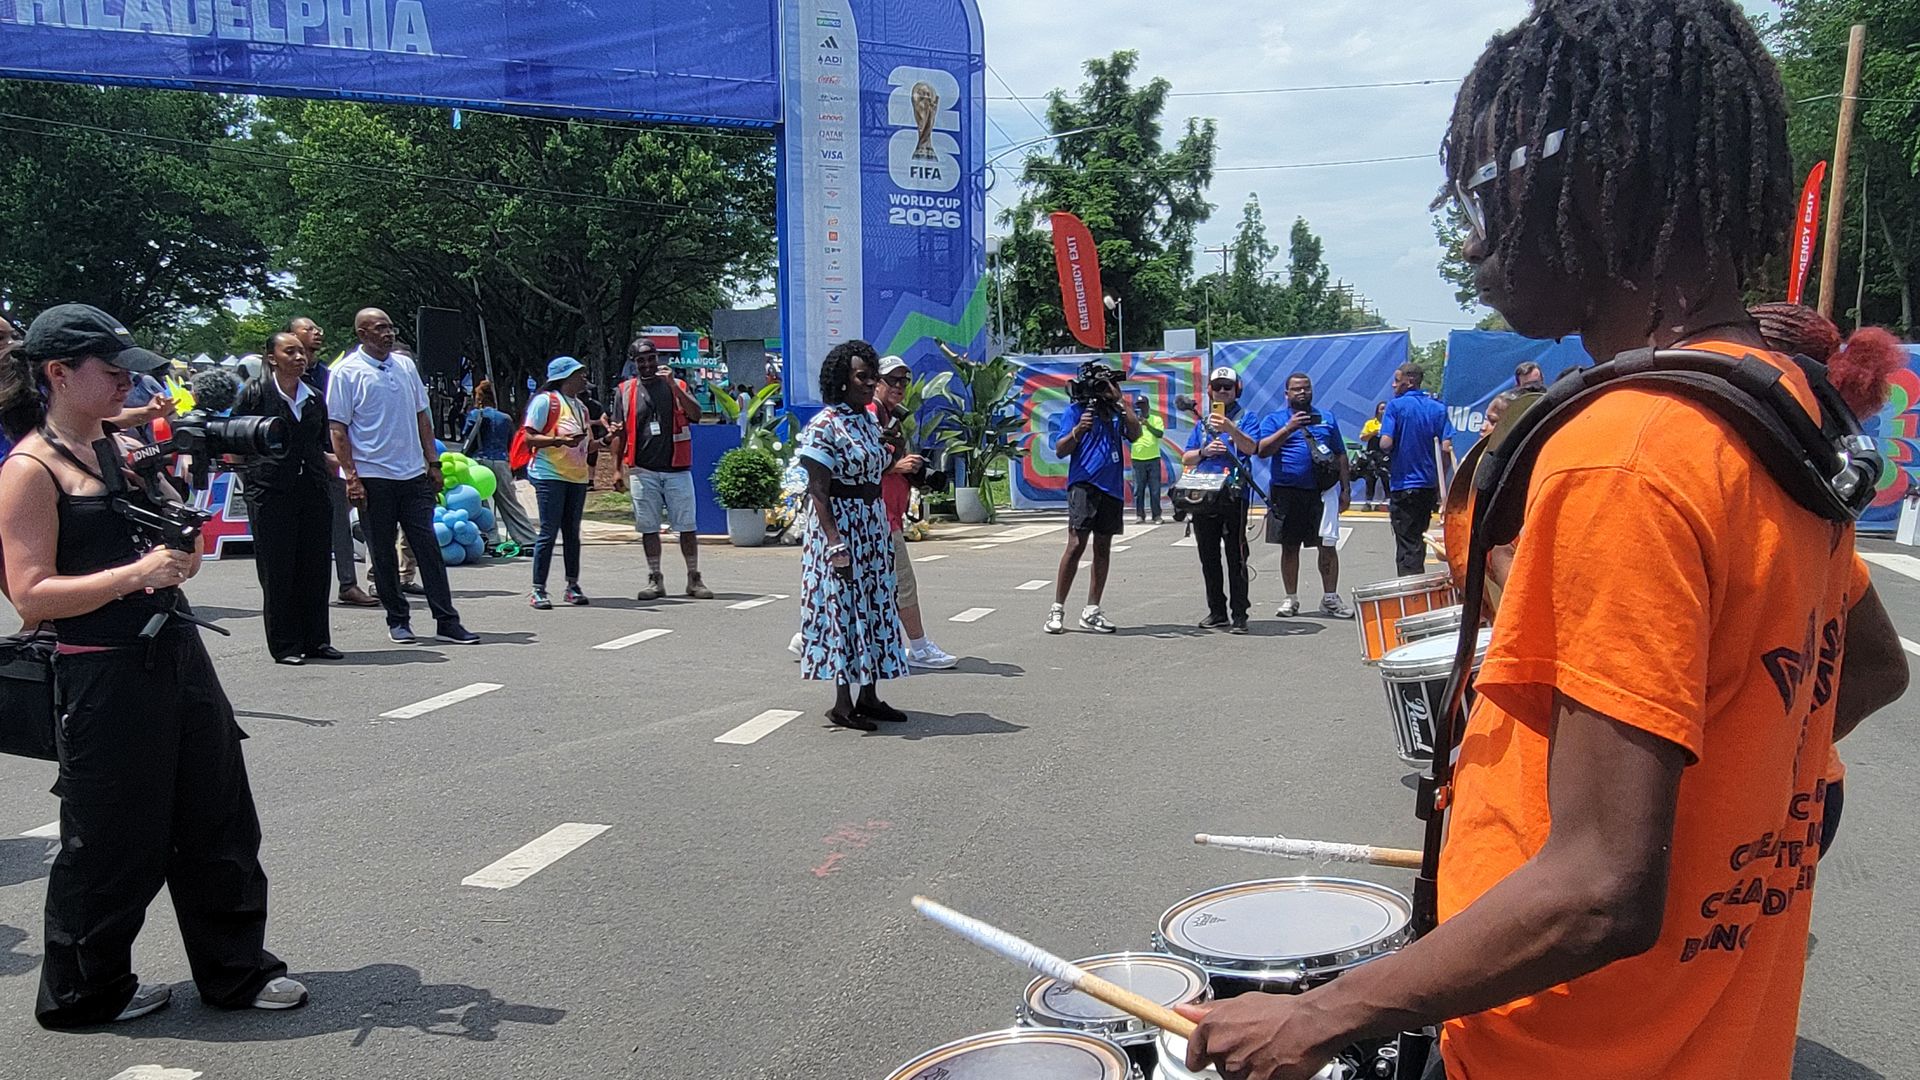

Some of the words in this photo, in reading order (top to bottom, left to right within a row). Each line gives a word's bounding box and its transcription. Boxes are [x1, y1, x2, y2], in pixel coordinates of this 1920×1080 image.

[819, 130, 843, 138] QATAR
[820, 150, 843, 160] VISA
[910, 166, 942, 180] FIFA
[889, 193, 934, 207] WORLD
[936, 197, 961, 209] CUP
[1804, 192, 1815, 223] EXIT
[889, 207, 961, 228] 2026
[1066, 235, 1079, 260] EXIT
[1071, 263, 1090, 330] EMERGENCY
[669, 356, 717, 366] CASAMIGOS
[1402, 689, 1434, 753] Pearl
